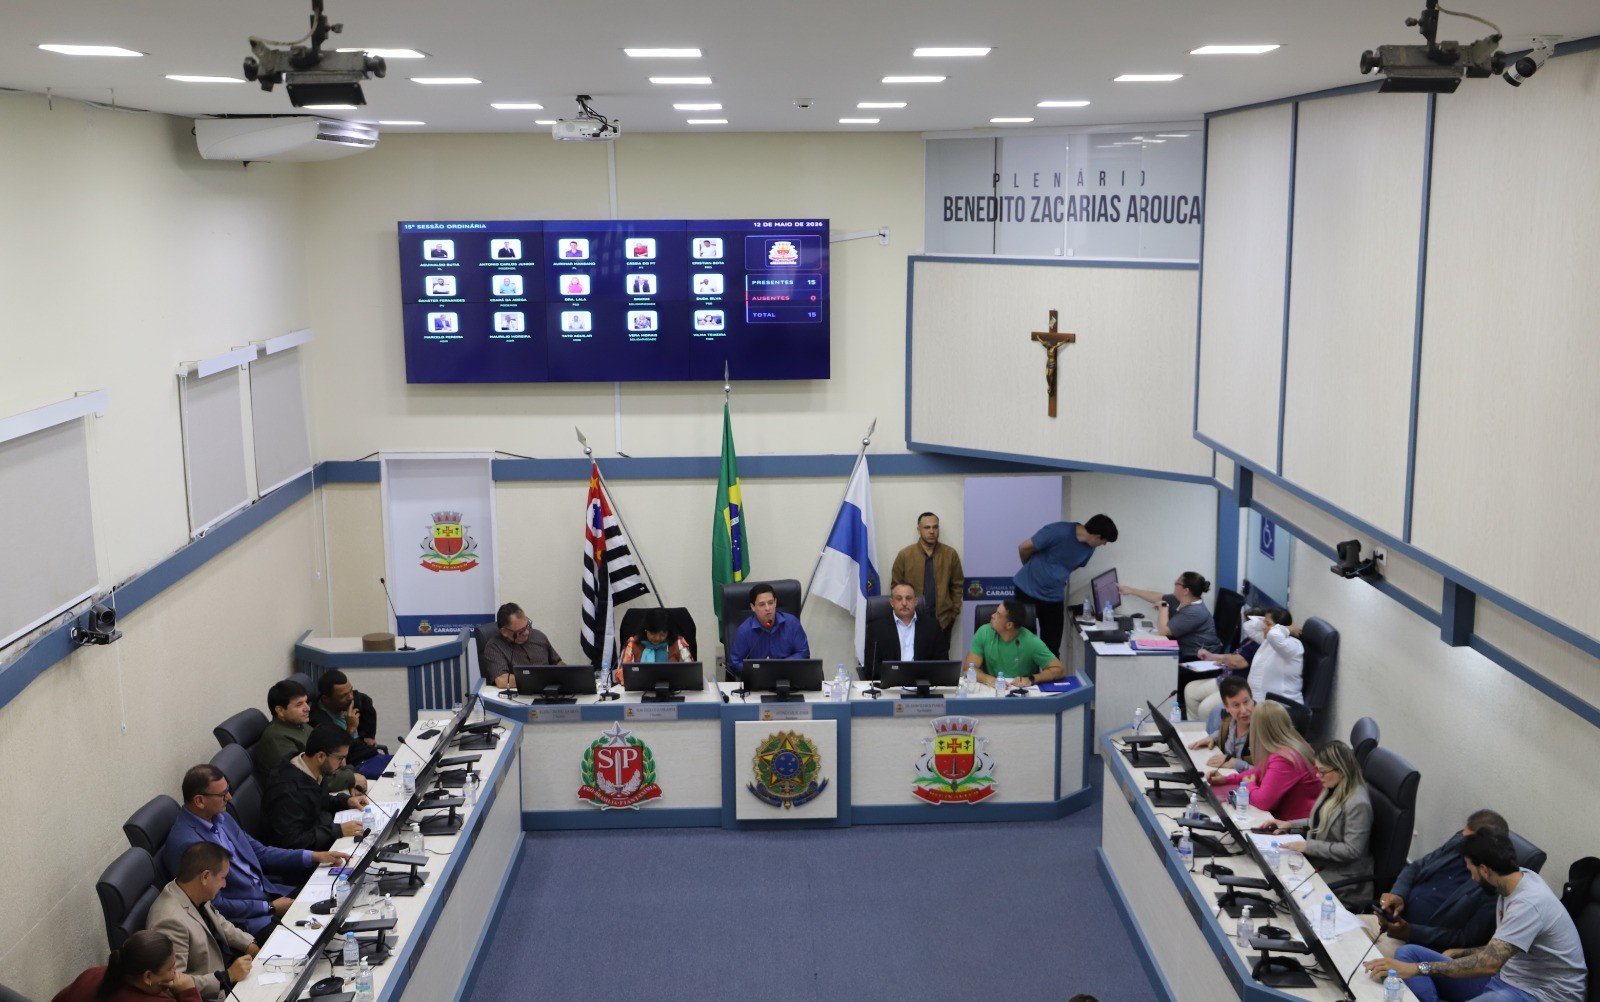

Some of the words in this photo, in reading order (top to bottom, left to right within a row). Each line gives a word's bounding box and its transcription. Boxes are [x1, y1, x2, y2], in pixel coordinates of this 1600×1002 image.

[943, 195, 1026, 222] BENEDITO
[1030, 194, 1121, 223] ZACARIAS
[1126, 194, 1201, 224] AROUCA
